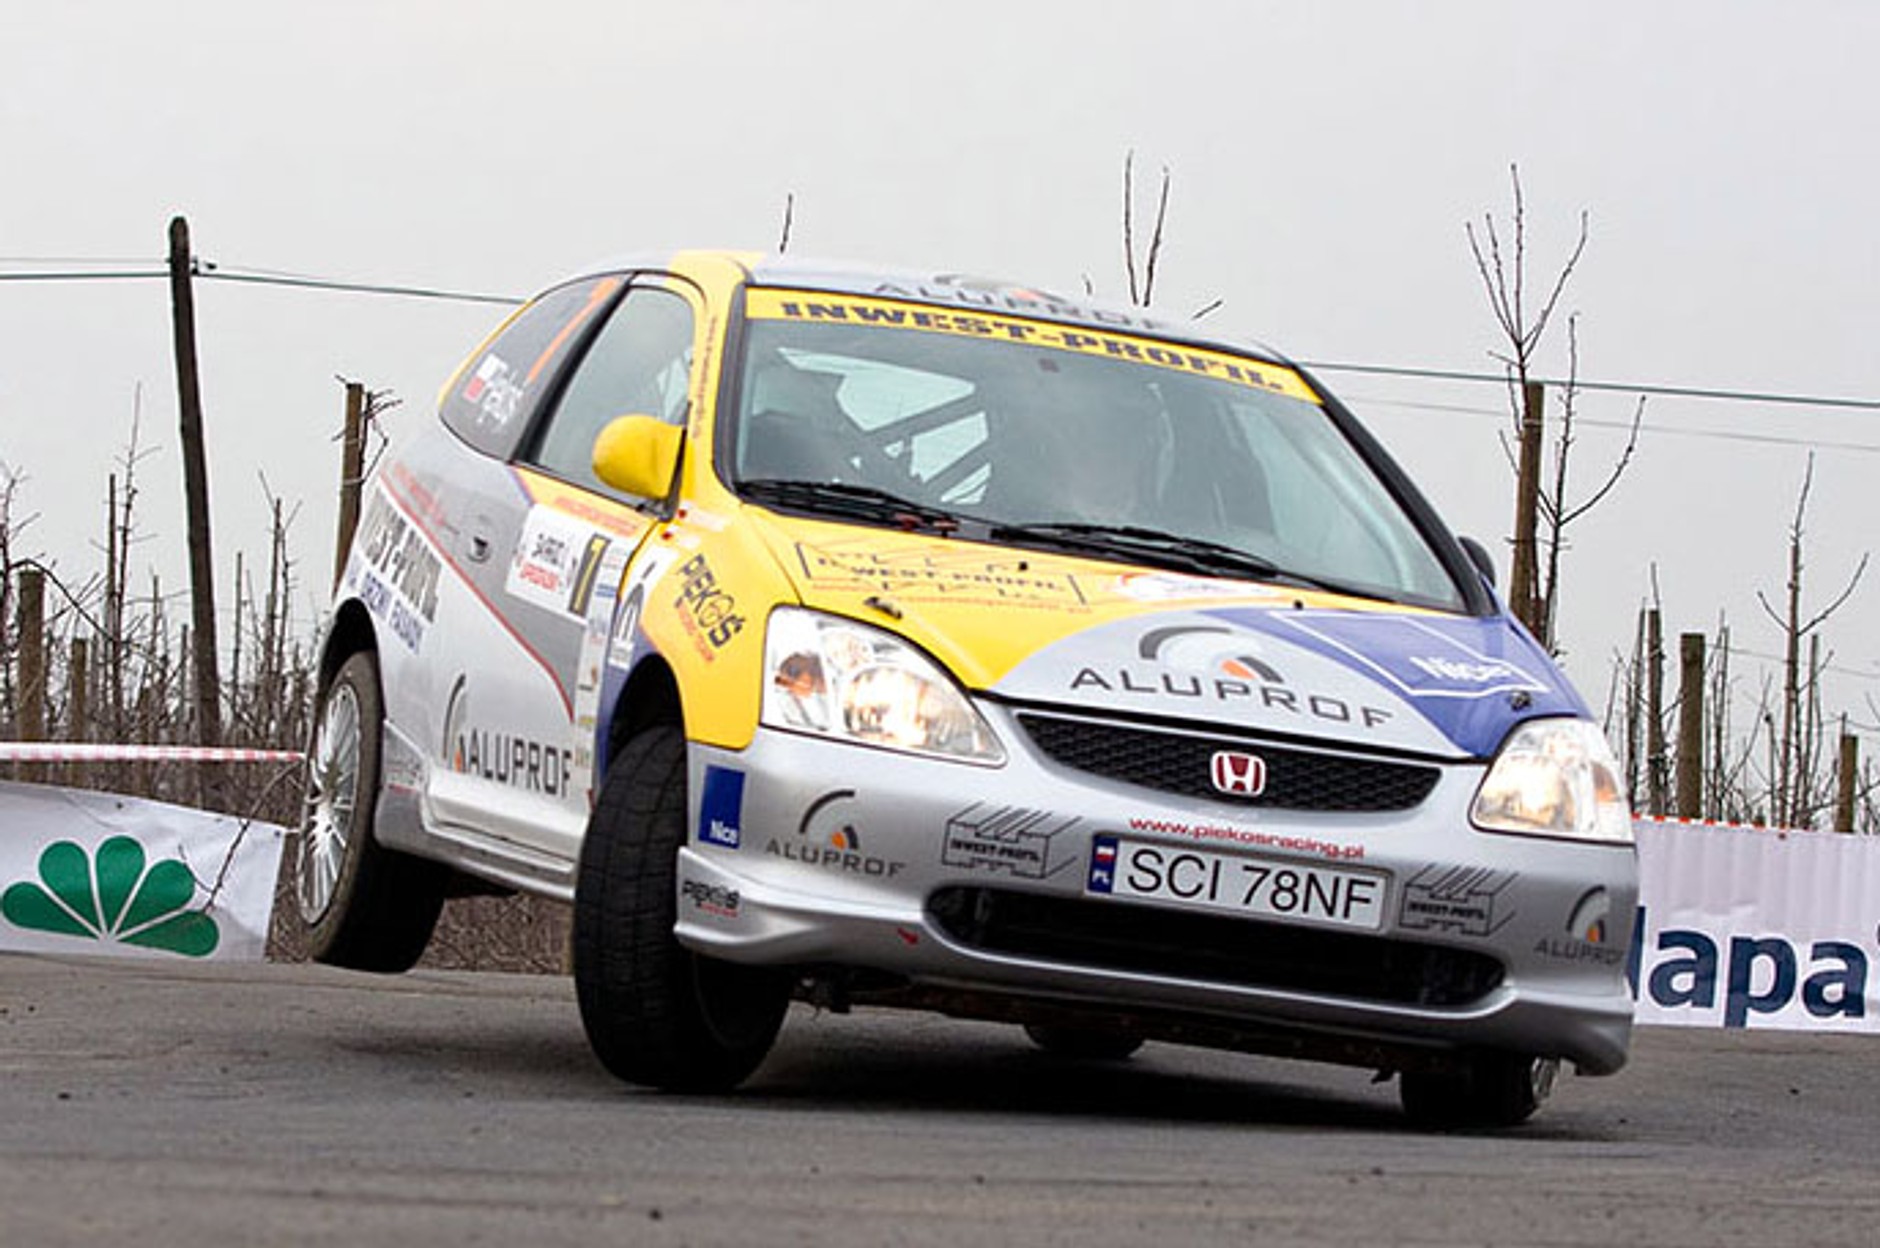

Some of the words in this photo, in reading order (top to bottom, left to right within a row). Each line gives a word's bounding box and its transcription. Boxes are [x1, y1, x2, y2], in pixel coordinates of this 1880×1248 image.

[1070, 667, 1393, 728] ALUPROF
[468, 727, 573, 798] ALUPROF
[765, 837, 908, 878] ALUPROF
[1129, 817, 1365, 858] www.piekosracing.pl
[1127, 848, 1222, 900] SCI
[1242, 865, 1378, 921] 78NF
